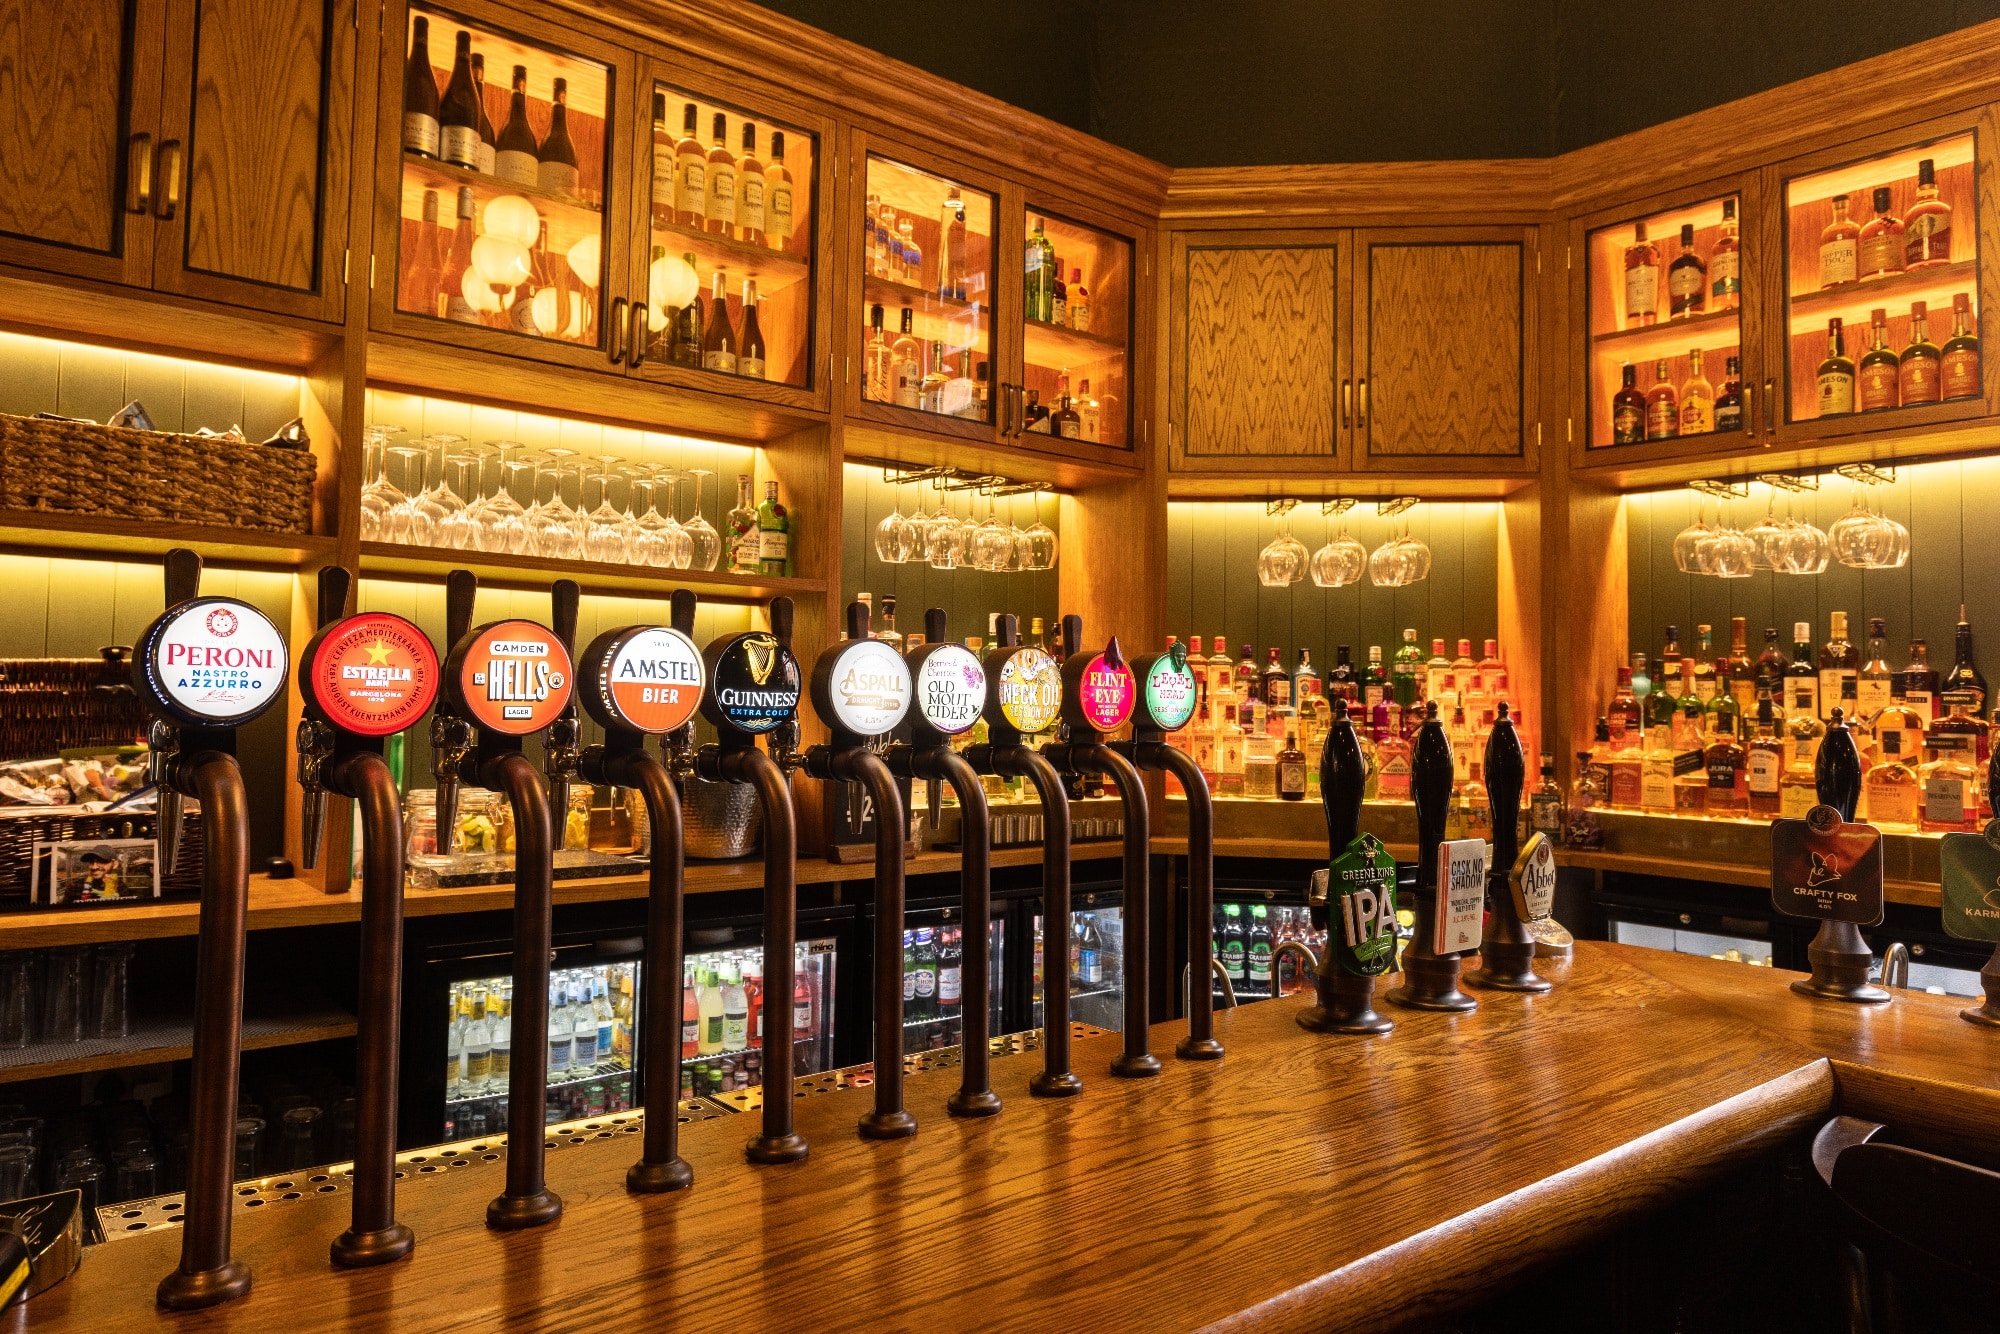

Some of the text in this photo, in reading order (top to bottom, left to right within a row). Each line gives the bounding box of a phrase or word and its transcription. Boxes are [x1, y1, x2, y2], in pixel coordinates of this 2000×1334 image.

[167, 643, 273, 669] PERONI
[329, 663, 337, 680] 1876
[333, 631, 365, 660] CERVEZA
[494, 644, 544, 653] CAMDEN
[192, 669, 249, 678] NASTRO
[342, 665, 412, 681] ESTRELLA
[619, 658, 697, 682] AMSTEL
[177, 678, 262, 689] AZZURRO
[487, 659, 549, 702] HELLS
[599, 641, 621, 718] AMSTEL BIER
[840, 667, 904, 694] ASPALL
[928, 680, 955, 693] OLD
[1089, 671, 1127, 687] FLINT
[1152, 672, 1193, 689] LEVEL
[329, 681, 422, 721] AUGUST KUENTZMANN DAMM
[350, 690, 403, 698] BARCELONA
[642, 687, 679, 704] BIER
[721, 688, 799, 707] GUINNESS
[927, 693, 972, 706] MOUT
[1003, 684, 1060, 706] NECK OIL
[1095, 688, 1121, 704] EYE
[1159, 689, 1186, 700] HEAD
[730, 708, 762, 716] EXTRA
[927, 705, 969, 719] CIDER
[1010, 706, 1055, 718] SESSION IPA
[1095, 708, 1119, 716] LAGER
[1342, 866, 1395, 880] GREENE KING
[1451, 858, 1483, 876] CASK NO
[1450, 873, 1483, 891] SHADOW
[1536, 889, 1548, 898] ALE
[1793, 887, 1858, 902] CRAFTY FOX
[1341, 884, 1398, 948] IPA
